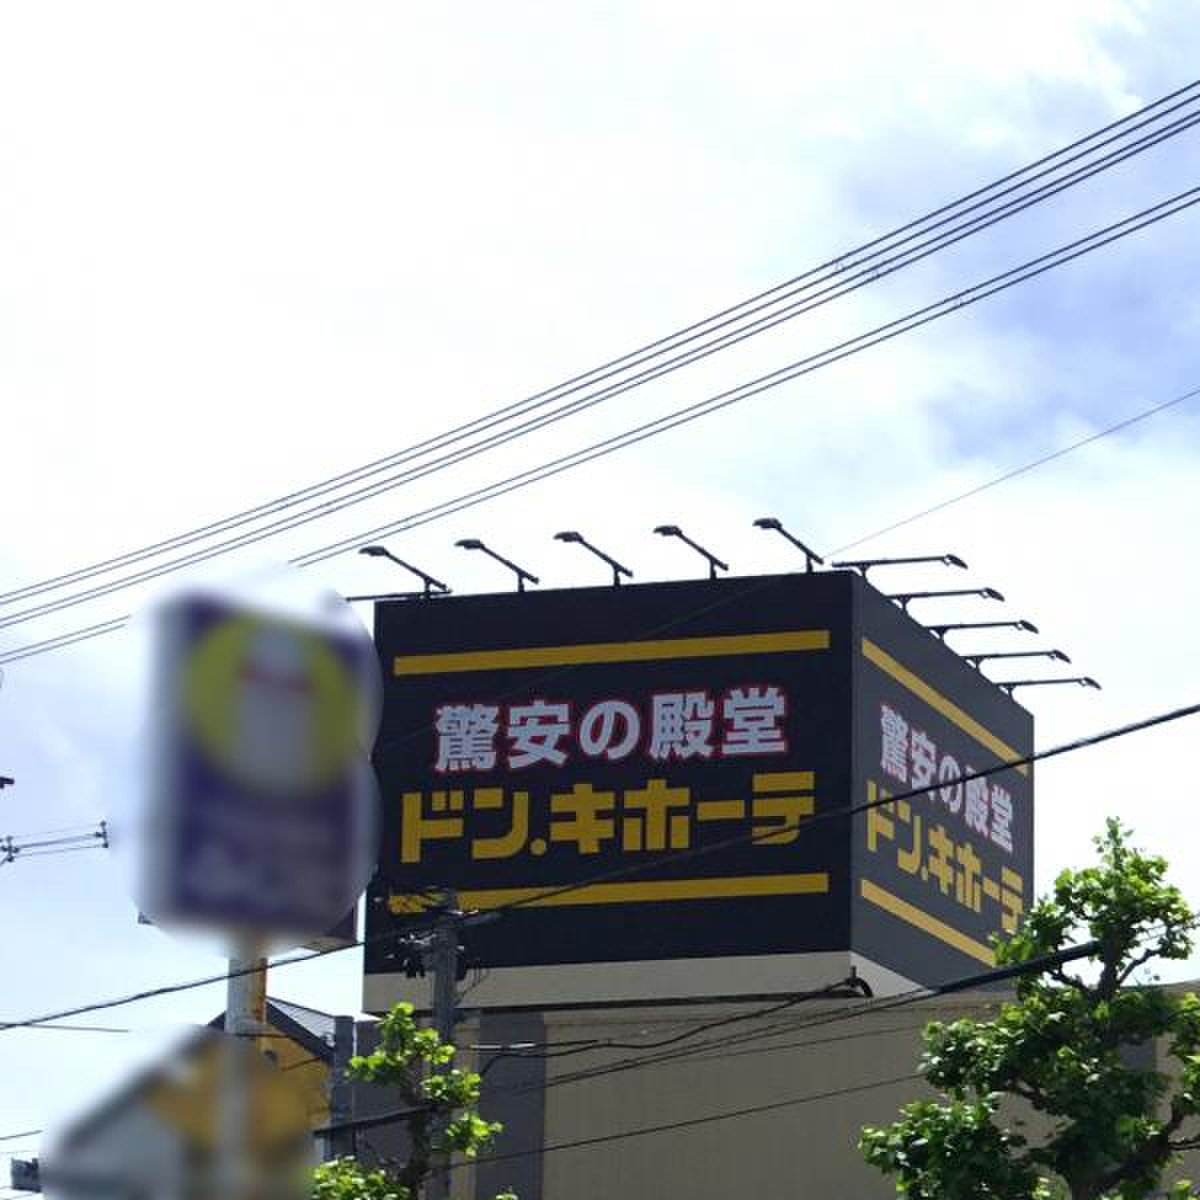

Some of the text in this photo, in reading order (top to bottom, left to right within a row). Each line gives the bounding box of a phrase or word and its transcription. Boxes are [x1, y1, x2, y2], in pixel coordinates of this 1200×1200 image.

[434, 686, 788, 773] 驚安の殿堂
[881, 703, 1013, 854] 驚安の殿堂
